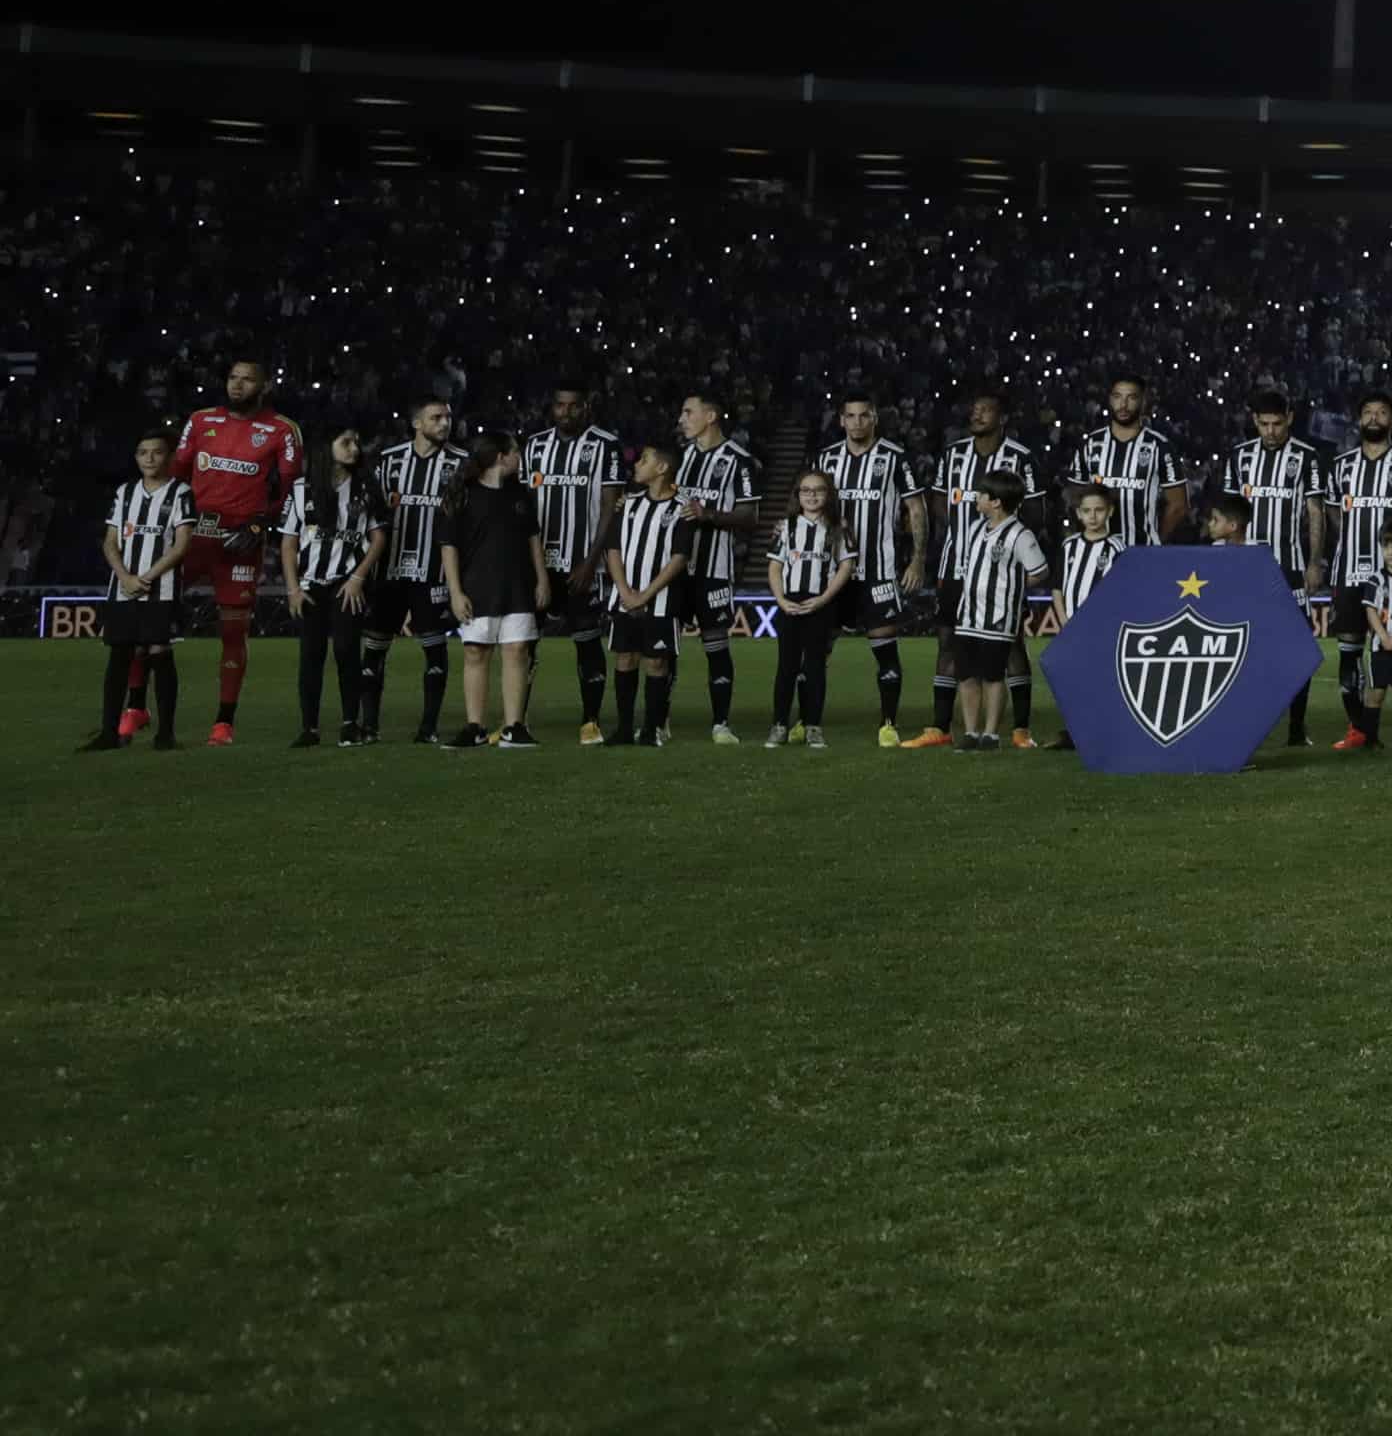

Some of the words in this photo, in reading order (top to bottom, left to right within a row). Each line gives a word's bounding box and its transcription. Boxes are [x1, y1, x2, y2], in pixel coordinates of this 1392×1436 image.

[211, 458, 257, 473] BETANO
[543, 474, 588, 486] BETANO
[1103, 477, 1145, 490] BETANO
[1251, 486, 1292, 499] BETANO
[400, 494, 443, 506] BETAN
[52, 605, 104, 637] BR
[1137, 635, 1227, 656] CAM
